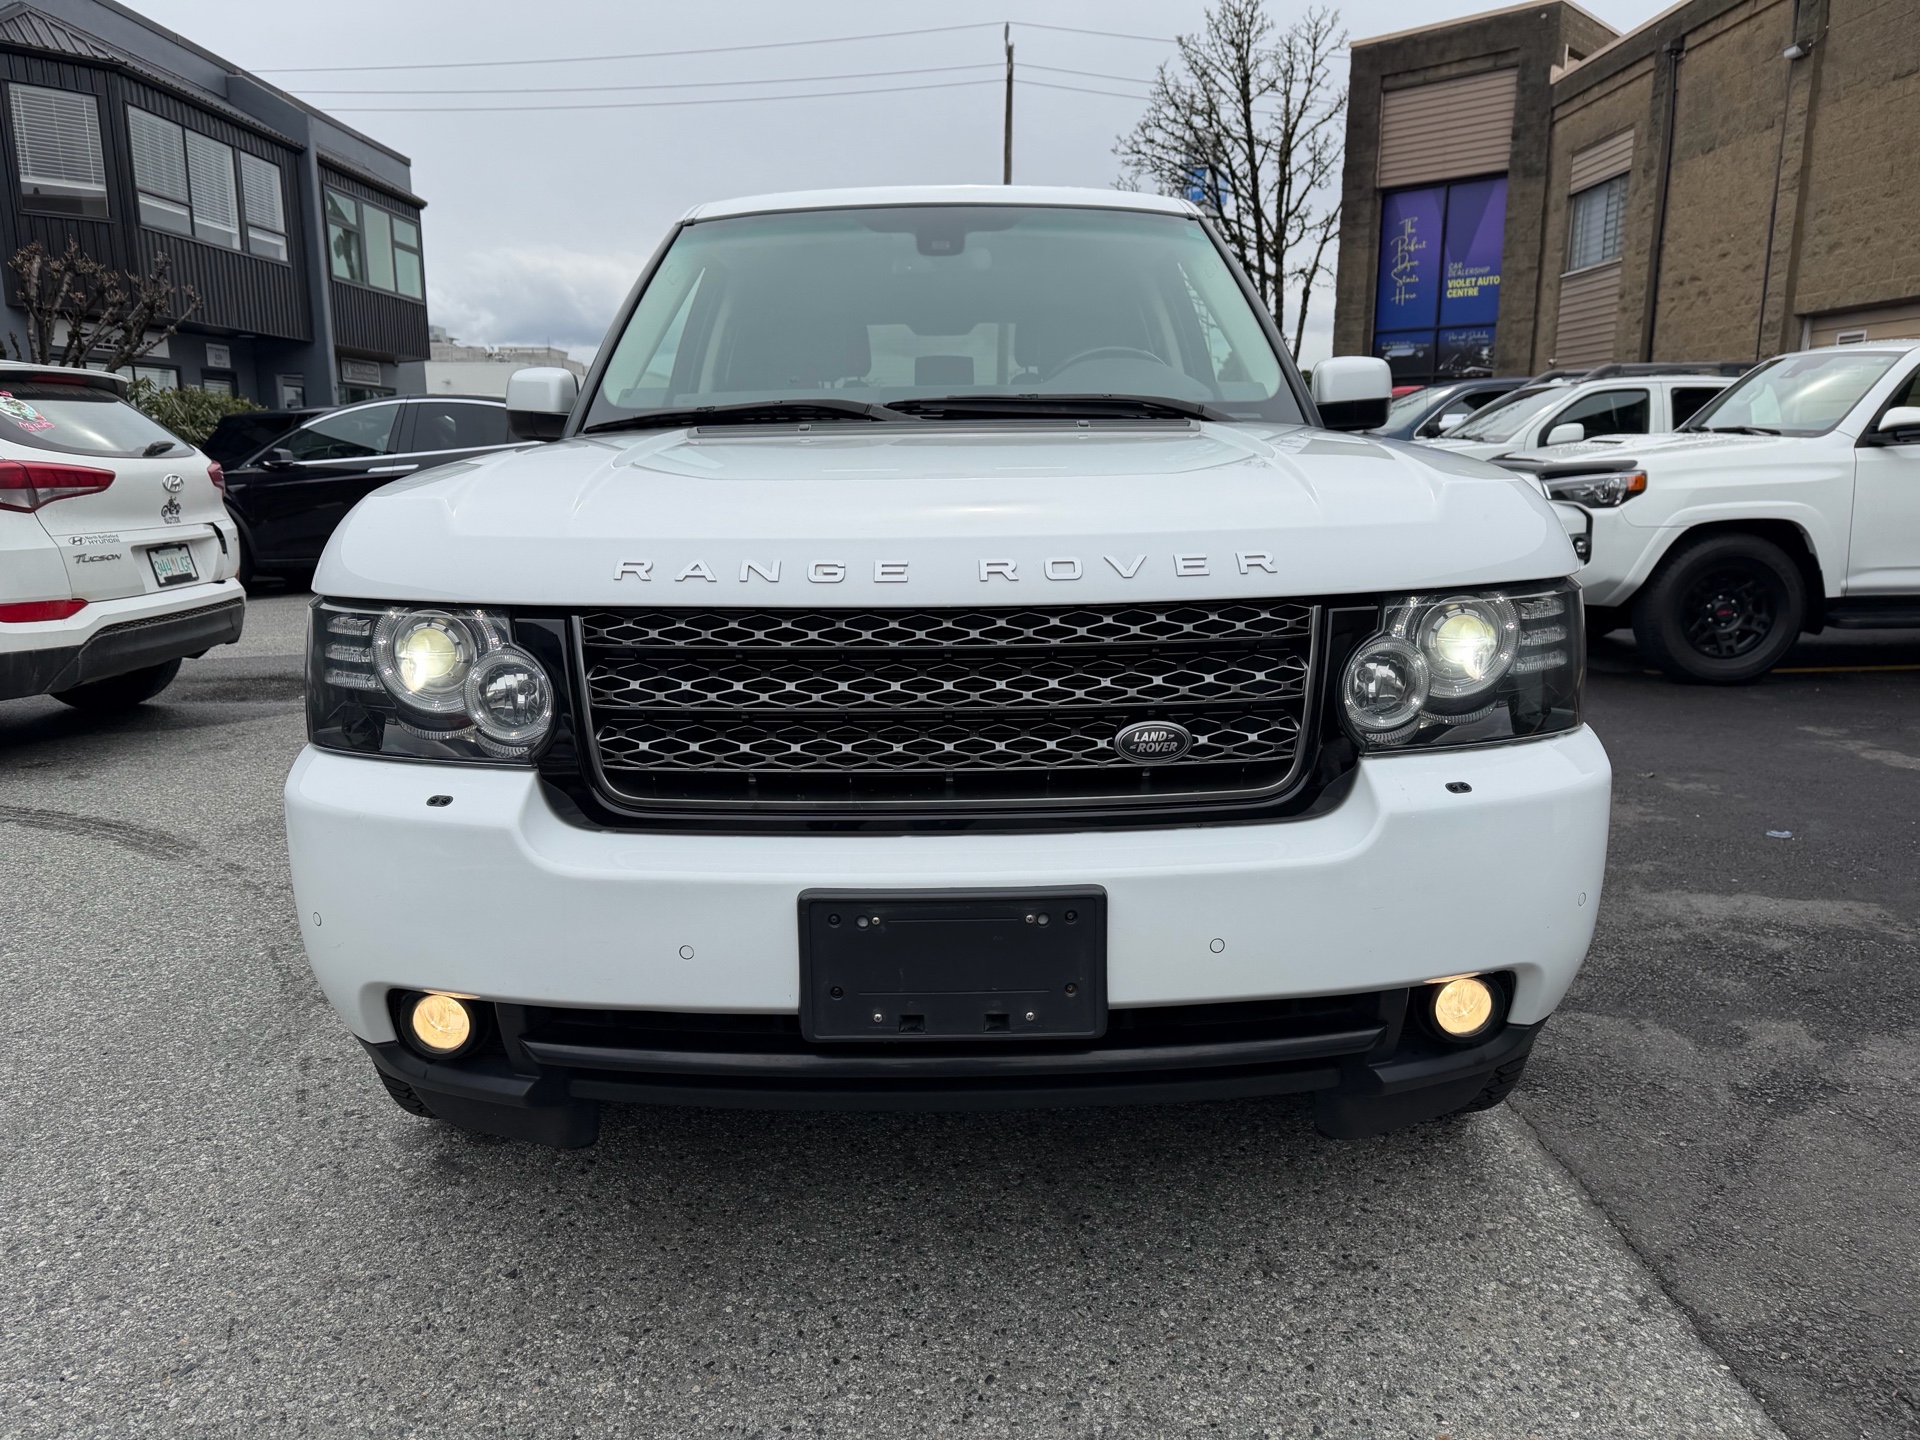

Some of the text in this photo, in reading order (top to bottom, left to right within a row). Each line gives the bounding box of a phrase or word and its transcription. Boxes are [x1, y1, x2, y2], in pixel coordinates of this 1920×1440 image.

[1448, 266, 1490, 278] DEALERSHIP
[1449, 262, 1463, 270] CAR
[1448, 275, 1501, 288] VIOLET AUTO
[1446, 286, 1479, 298] CENTRE
[153, 561, 173, 577] 344
[612, 550, 1278, 583] RANGE ROVER
[1133, 731, 1167, 742] LAND
[1136, 741, 1178, 753] ROVER
